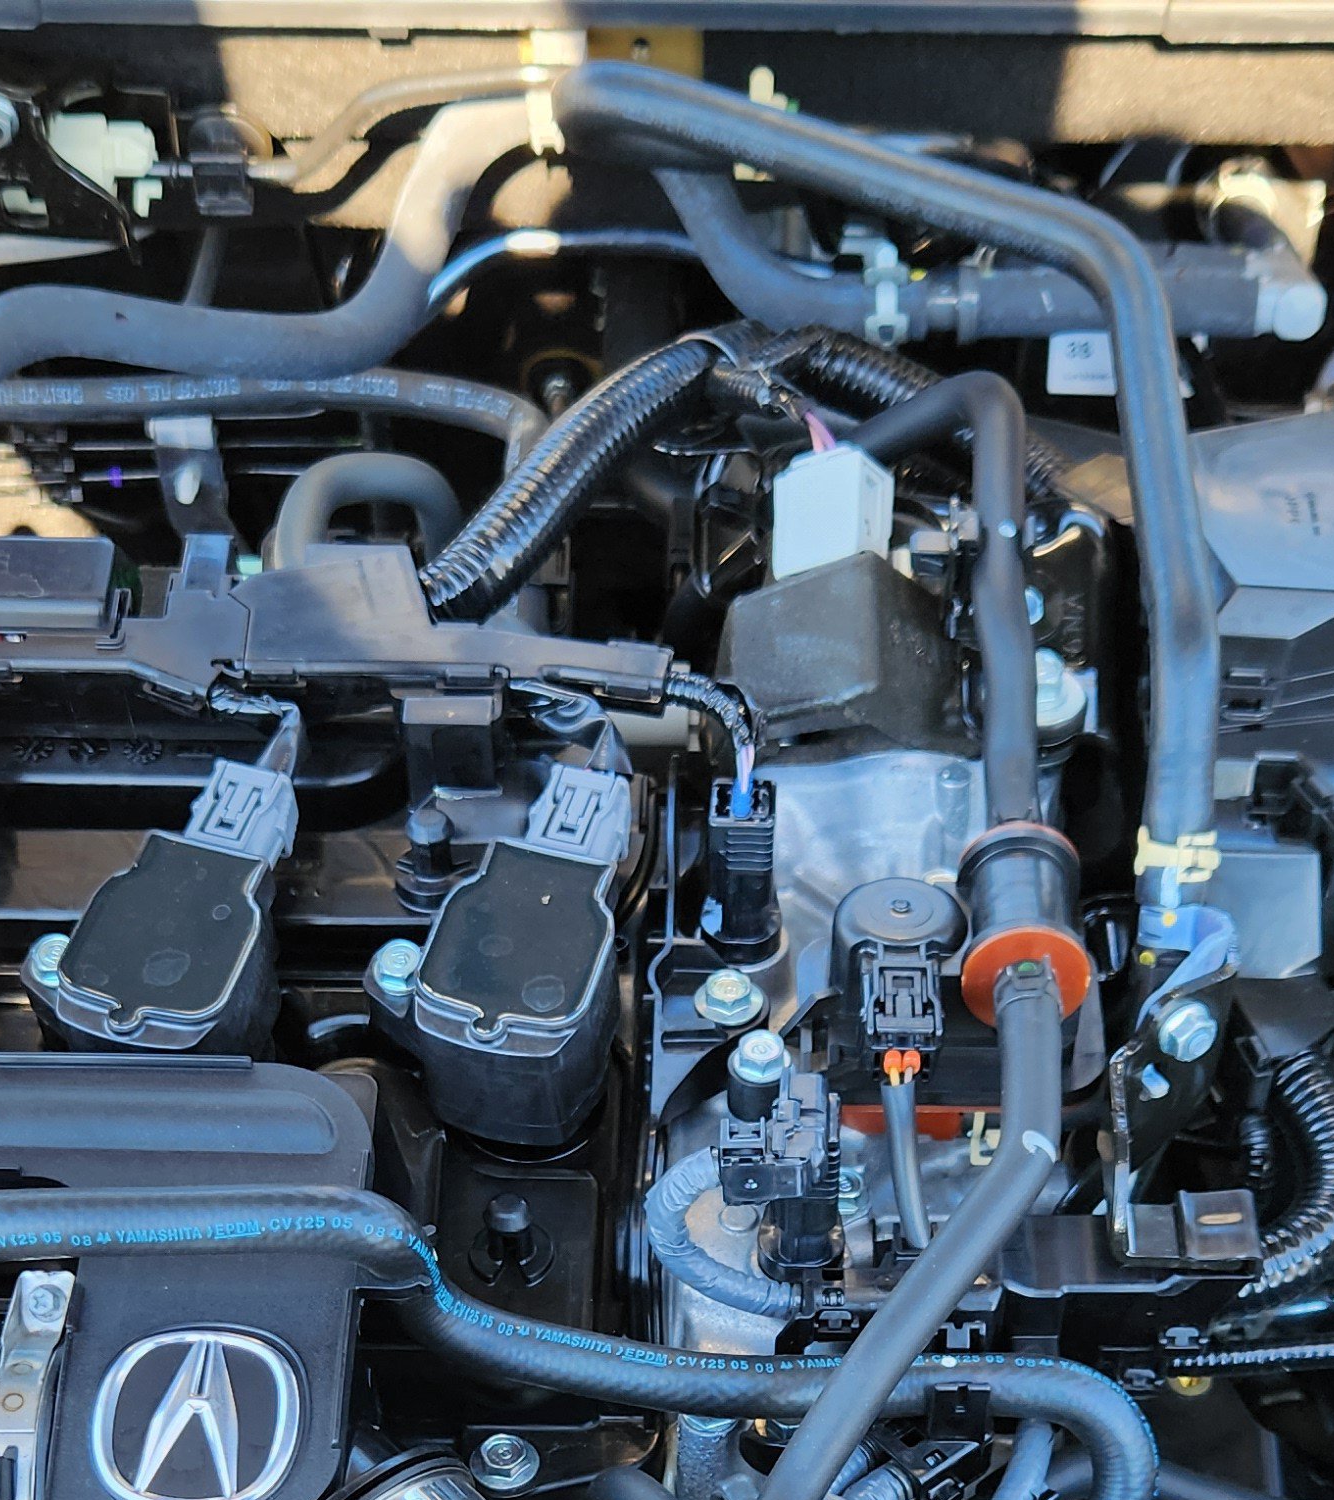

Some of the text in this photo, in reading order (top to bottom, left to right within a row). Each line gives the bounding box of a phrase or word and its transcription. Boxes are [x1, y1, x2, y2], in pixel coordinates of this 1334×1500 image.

[43, 1232, 62, 1244] 05
[71, 1234, 93, 1247] 08
[116, 1226, 203, 1244] YAMASHITA
[331, 1217, 354, 1229] 05
[363, 1223, 385, 1238] 08
[407, 1233, 445, 1290] YAMASHITA
[480, 1313, 495, 1329] 05
[497, 1322, 515, 1337] 08
[534, 1326, 613, 1355] YAMASHITA
[730, 1358, 749, 1371] 05
[754, 1361, 774, 1374] 08
